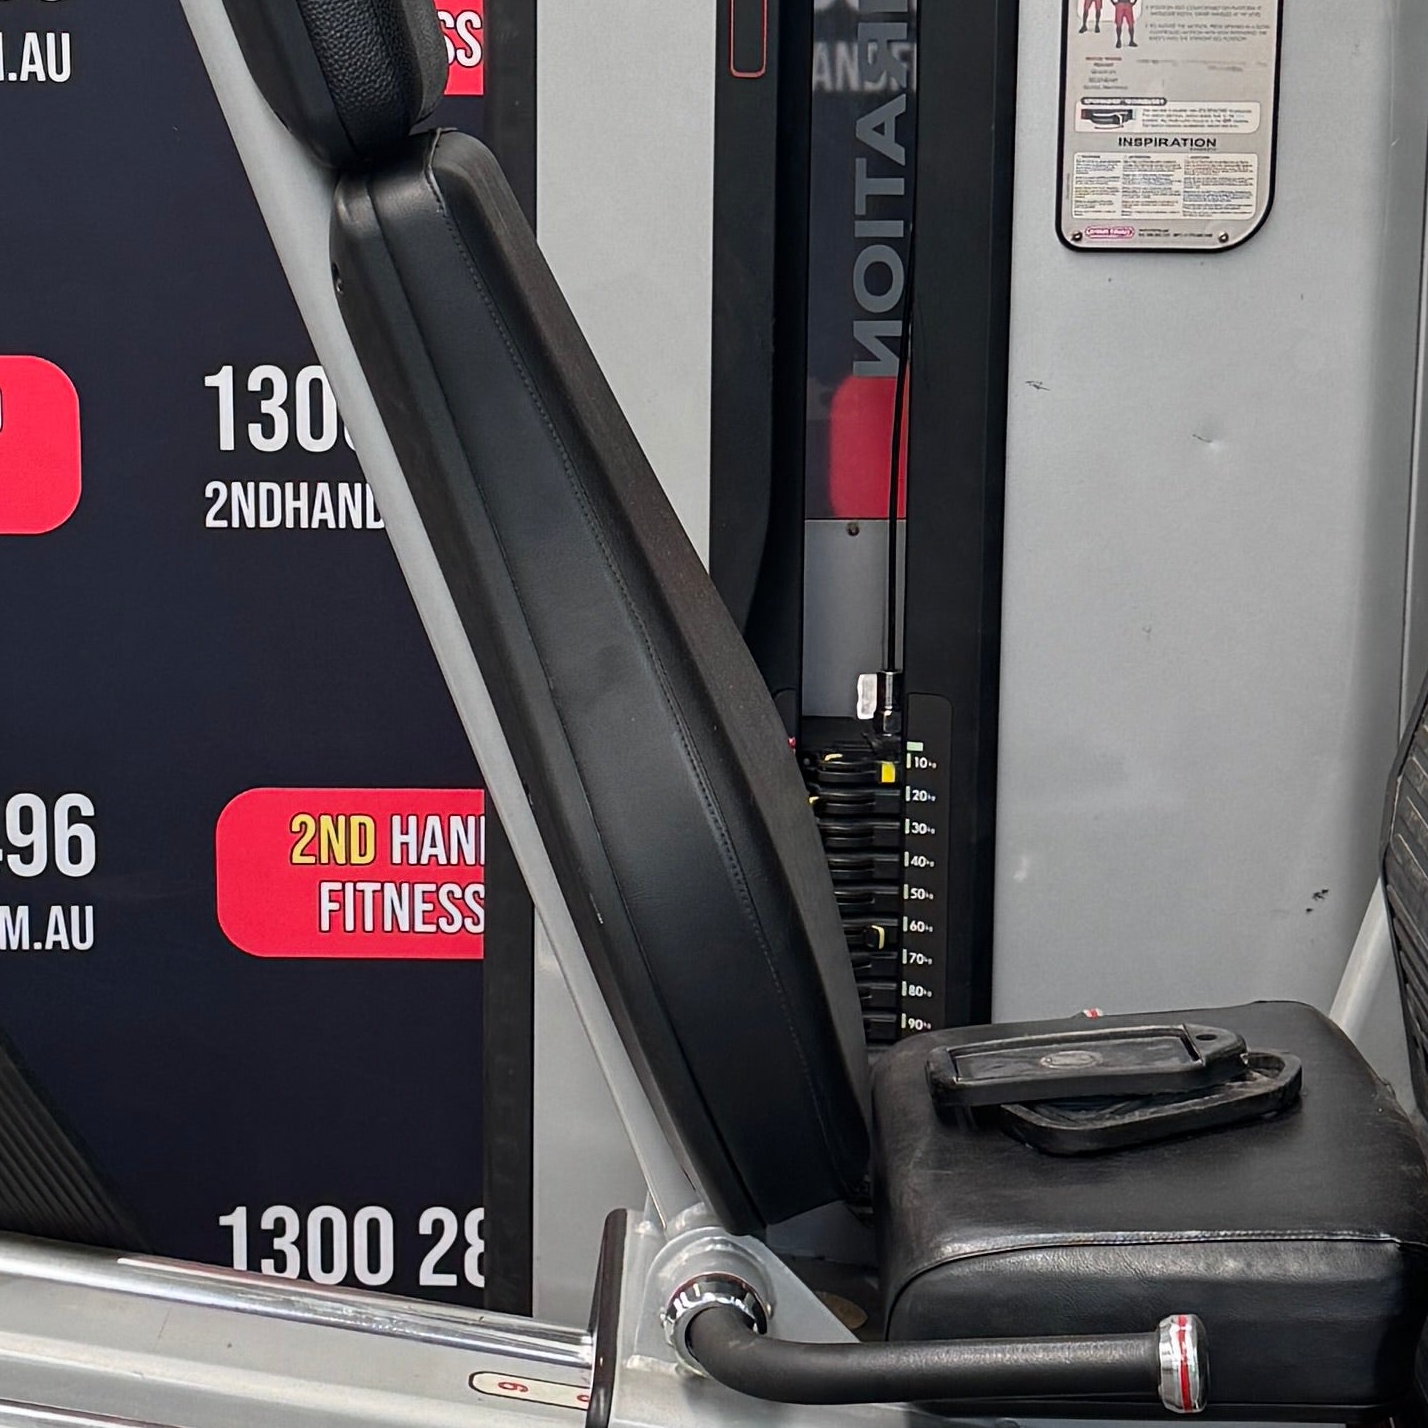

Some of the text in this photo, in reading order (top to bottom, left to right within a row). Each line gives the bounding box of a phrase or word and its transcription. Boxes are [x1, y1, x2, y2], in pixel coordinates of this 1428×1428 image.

[1118, 136, 1217, 149] INSPIRATION
[204, 365, 360, 452] 130
[291, 813, 486, 865] 2ND HAN
[320, 881, 485, 934] FITNESS
[218, 1205, 395, 1287] 1300
